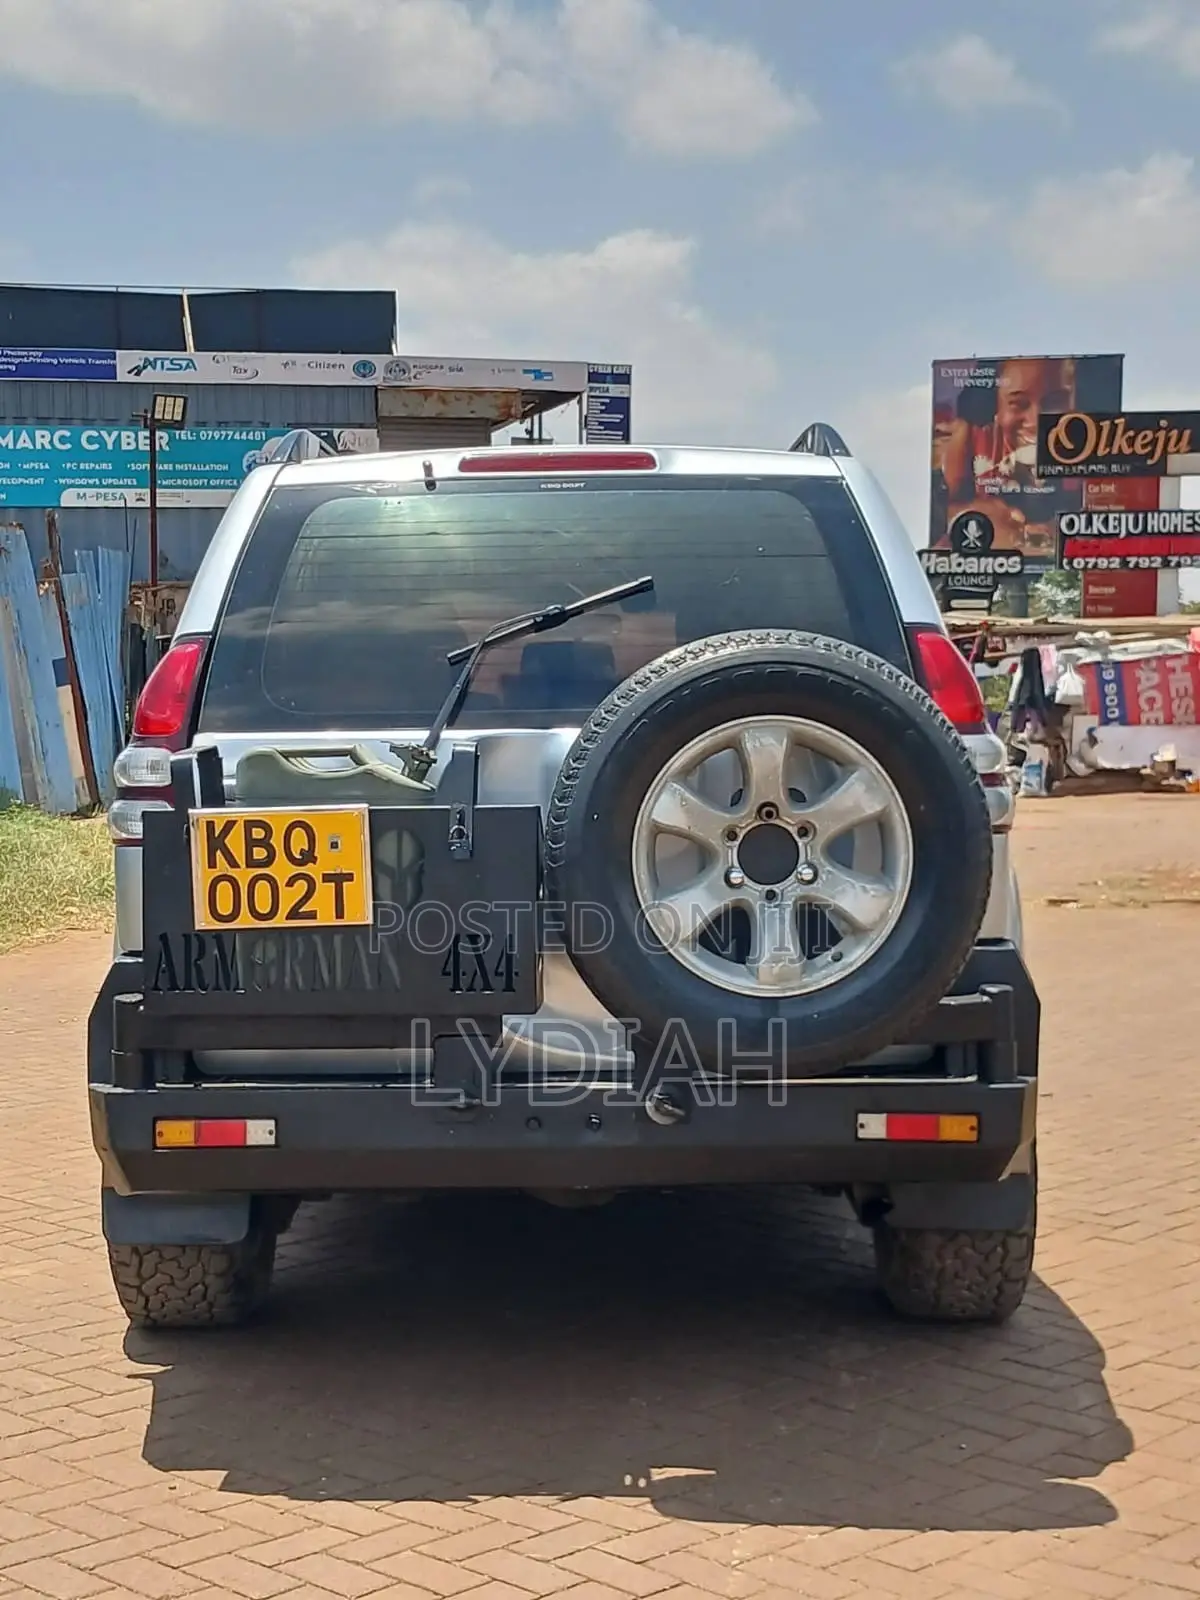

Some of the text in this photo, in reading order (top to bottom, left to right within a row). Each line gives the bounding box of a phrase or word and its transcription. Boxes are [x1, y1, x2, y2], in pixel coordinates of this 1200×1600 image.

[0, 430, 170, 450] MARC CYBER
[175, 430, 196, 441] TEL:
[1048, 413, 1192, 465] Olkeju
[131, 463, 173, 471] SOFTARE
[102, 478, 137, 486] UPDATES
[162, 478, 208, 486] MICROSOFT
[76, 492, 126, 501] M-PESA
[1060, 512, 1144, 538] OLKEJU
[920, 552, 1022, 574] Habanos
[1072, 556, 1120, 569] 0792
[1126, 556, 1162, 568] 792
[948, 575, 994, 586] LOUNGE
[206, 819, 318, 870] KBQ
[207, 872, 355, 923] 002T
